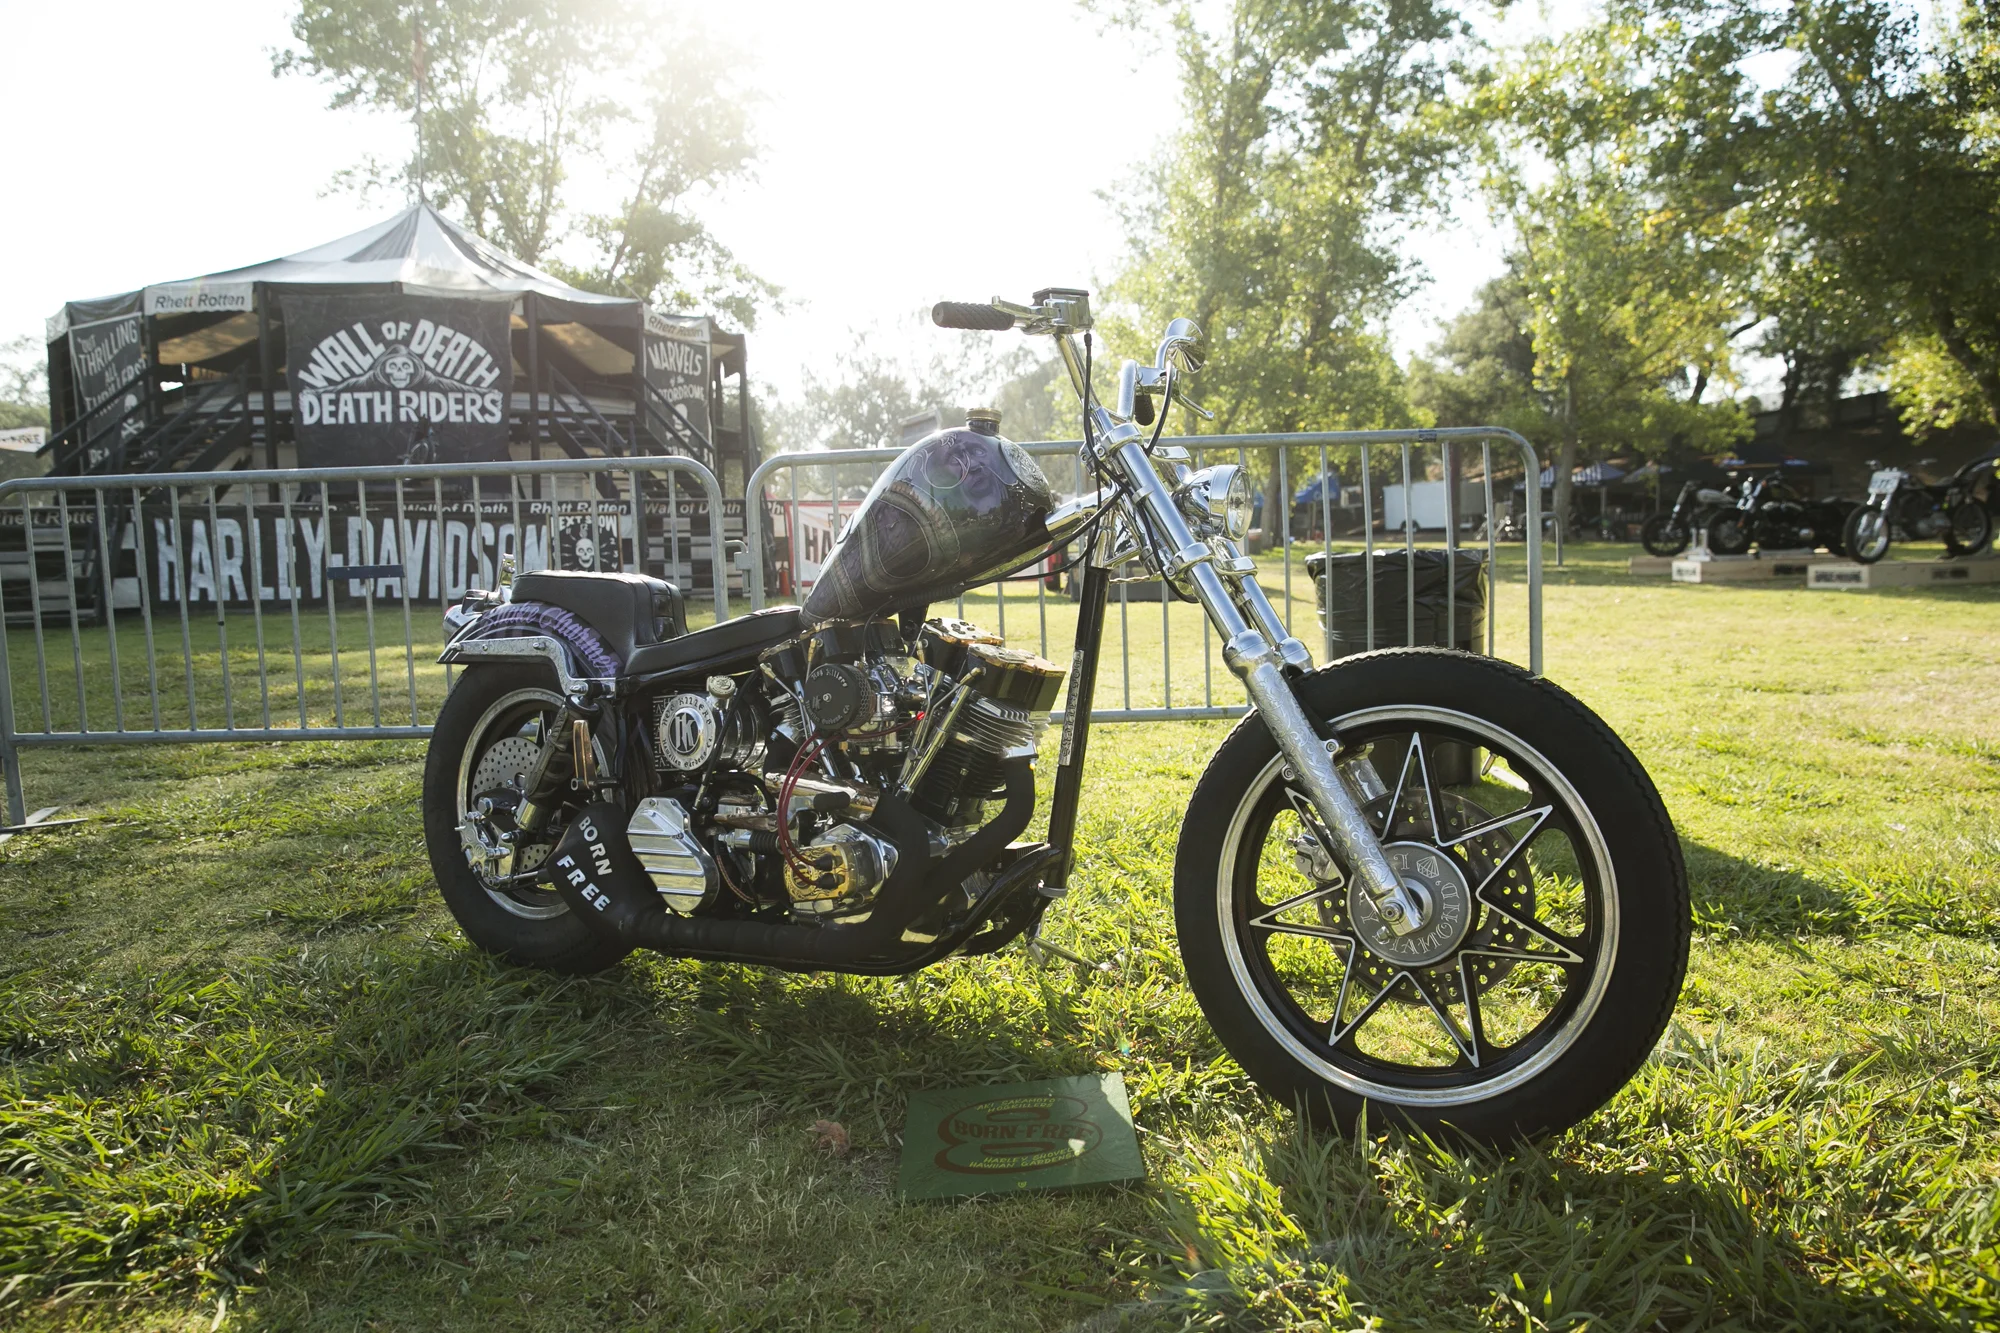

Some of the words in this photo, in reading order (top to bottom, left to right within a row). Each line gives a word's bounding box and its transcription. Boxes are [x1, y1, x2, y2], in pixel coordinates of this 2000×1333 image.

[155, 296, 193, 309] Rhett
[197, 293, 245, 307] Rotten
[78, 319, 139, 377] THRILLING
[298, 321, 386, 388] WALL
[381, 320, 411, 341] OF
[409, 318, 500, 388] DEATH
[648, 340, 703, 376] MARVELS
[301, 390, 393, 425] DEATH
[400, 390, 503, 425] RIDERS
[46, 511, 95, 525] Rtte
[530, 502, 573, 514] Rhtt
[577, 502, 627, 514] Rten
[645, 502, 675, 514] Wal
[680, 503, 695, 514] of
[699, 502, 741, 514] Dth
[585, 515, 617, 538] SOW
[155, 516, 548, 600] HARLEY-DAVIDSON
[578, 815, 613, 876] BORN
[556, 854, 611, 912] FREE
[954, 1120, 1095, 1141] BORN-FREE
[983, 1156, 1029, 1164] HARLEY
